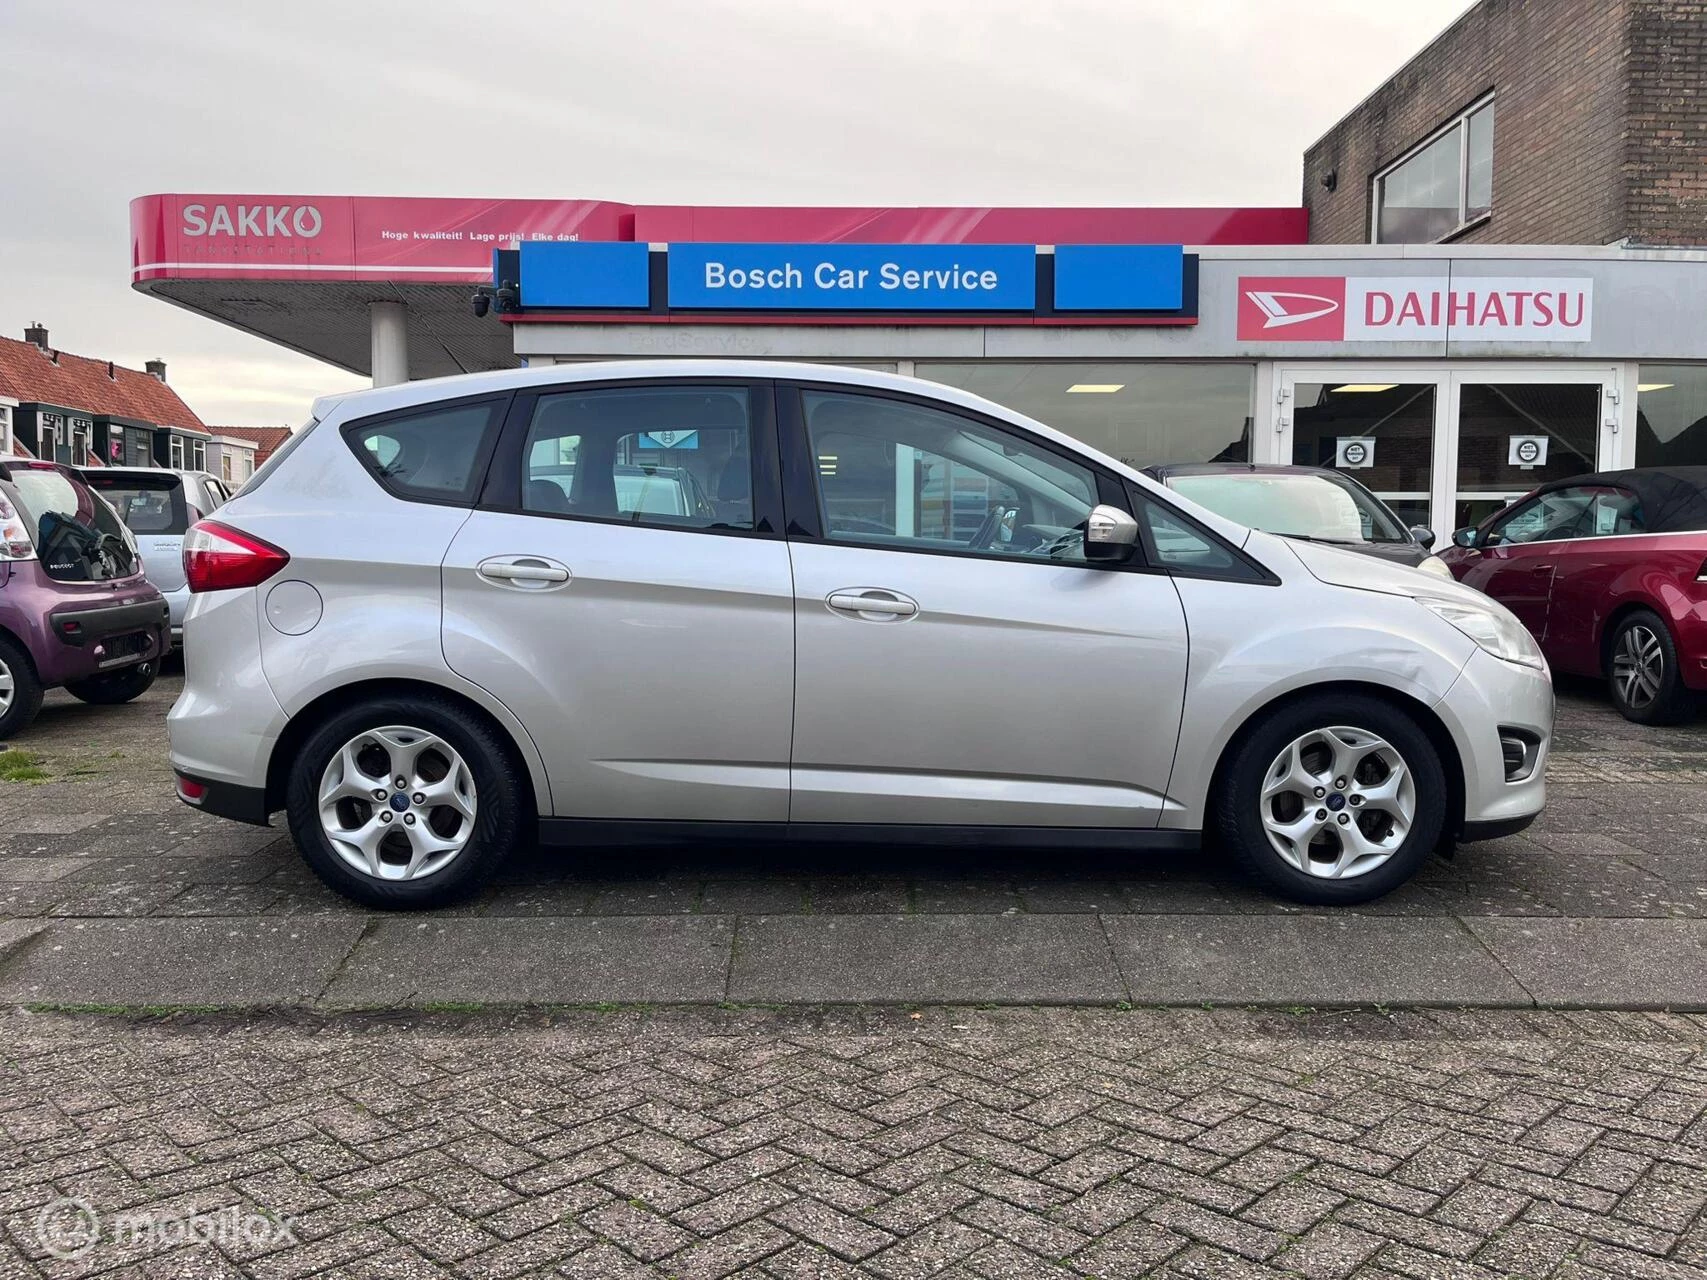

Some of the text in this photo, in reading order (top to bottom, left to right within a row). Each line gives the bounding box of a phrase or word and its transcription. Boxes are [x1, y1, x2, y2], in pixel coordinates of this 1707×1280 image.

[183, 204, 322, 237] SAKKO
[381, 230, 580, 242] Hoge kwaliteit! Lage prijs! Elke dag!
[704, 262, 998, 290] Bosch Car Service
[1364, 291, 1584, 327] DAIHATSU
